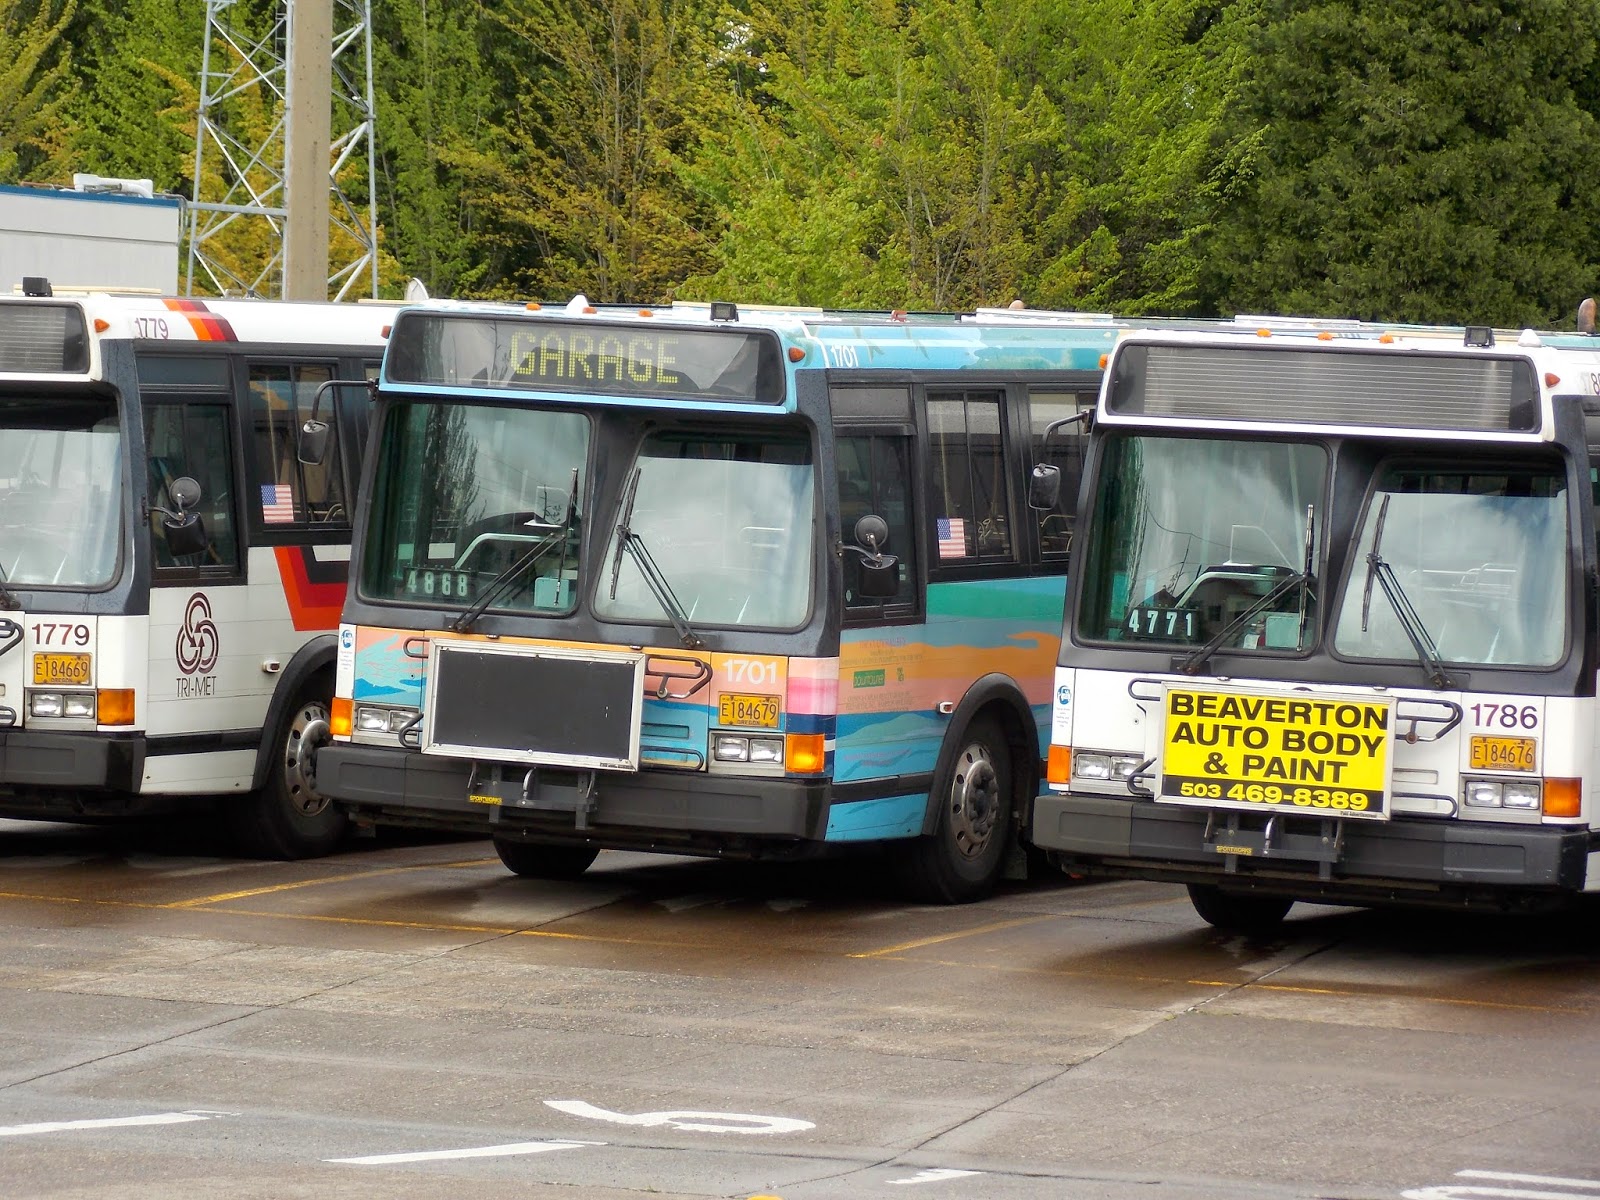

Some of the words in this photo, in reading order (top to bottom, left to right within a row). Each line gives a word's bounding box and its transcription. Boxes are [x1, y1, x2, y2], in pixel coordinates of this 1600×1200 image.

[135, 317, 169, 340] 1779
[510, 331, 679, 384] GARAGE
[830, 344, 859, 367] 1701
[407, 570, 468, 597] 4868
[31, 623, 90, 646] 1779
[1128, 609, 1192, 637] 4771
[35, 660, 88, 677] E184669
[722, 659, 777, 685] 1701
[176, 676, 217, 697] TRI-MET
[721, 701, 777, 720] E184679
[1170, 693, 1388, 731] BEAVERTON
[1470, 703, 1538, 730] 1786
[1171, 722, 1269, 750] AUTO
[1281, 729, 1385, 758] BODY
[1473, 743, 1533, 764] E184676
[1203, 751, 1229, 775] &
[1242, 754, 1348, 784] PAINT
[1180, 782, 1222, 798] 503
[1227, 783, 1369, 811] 469-8389
